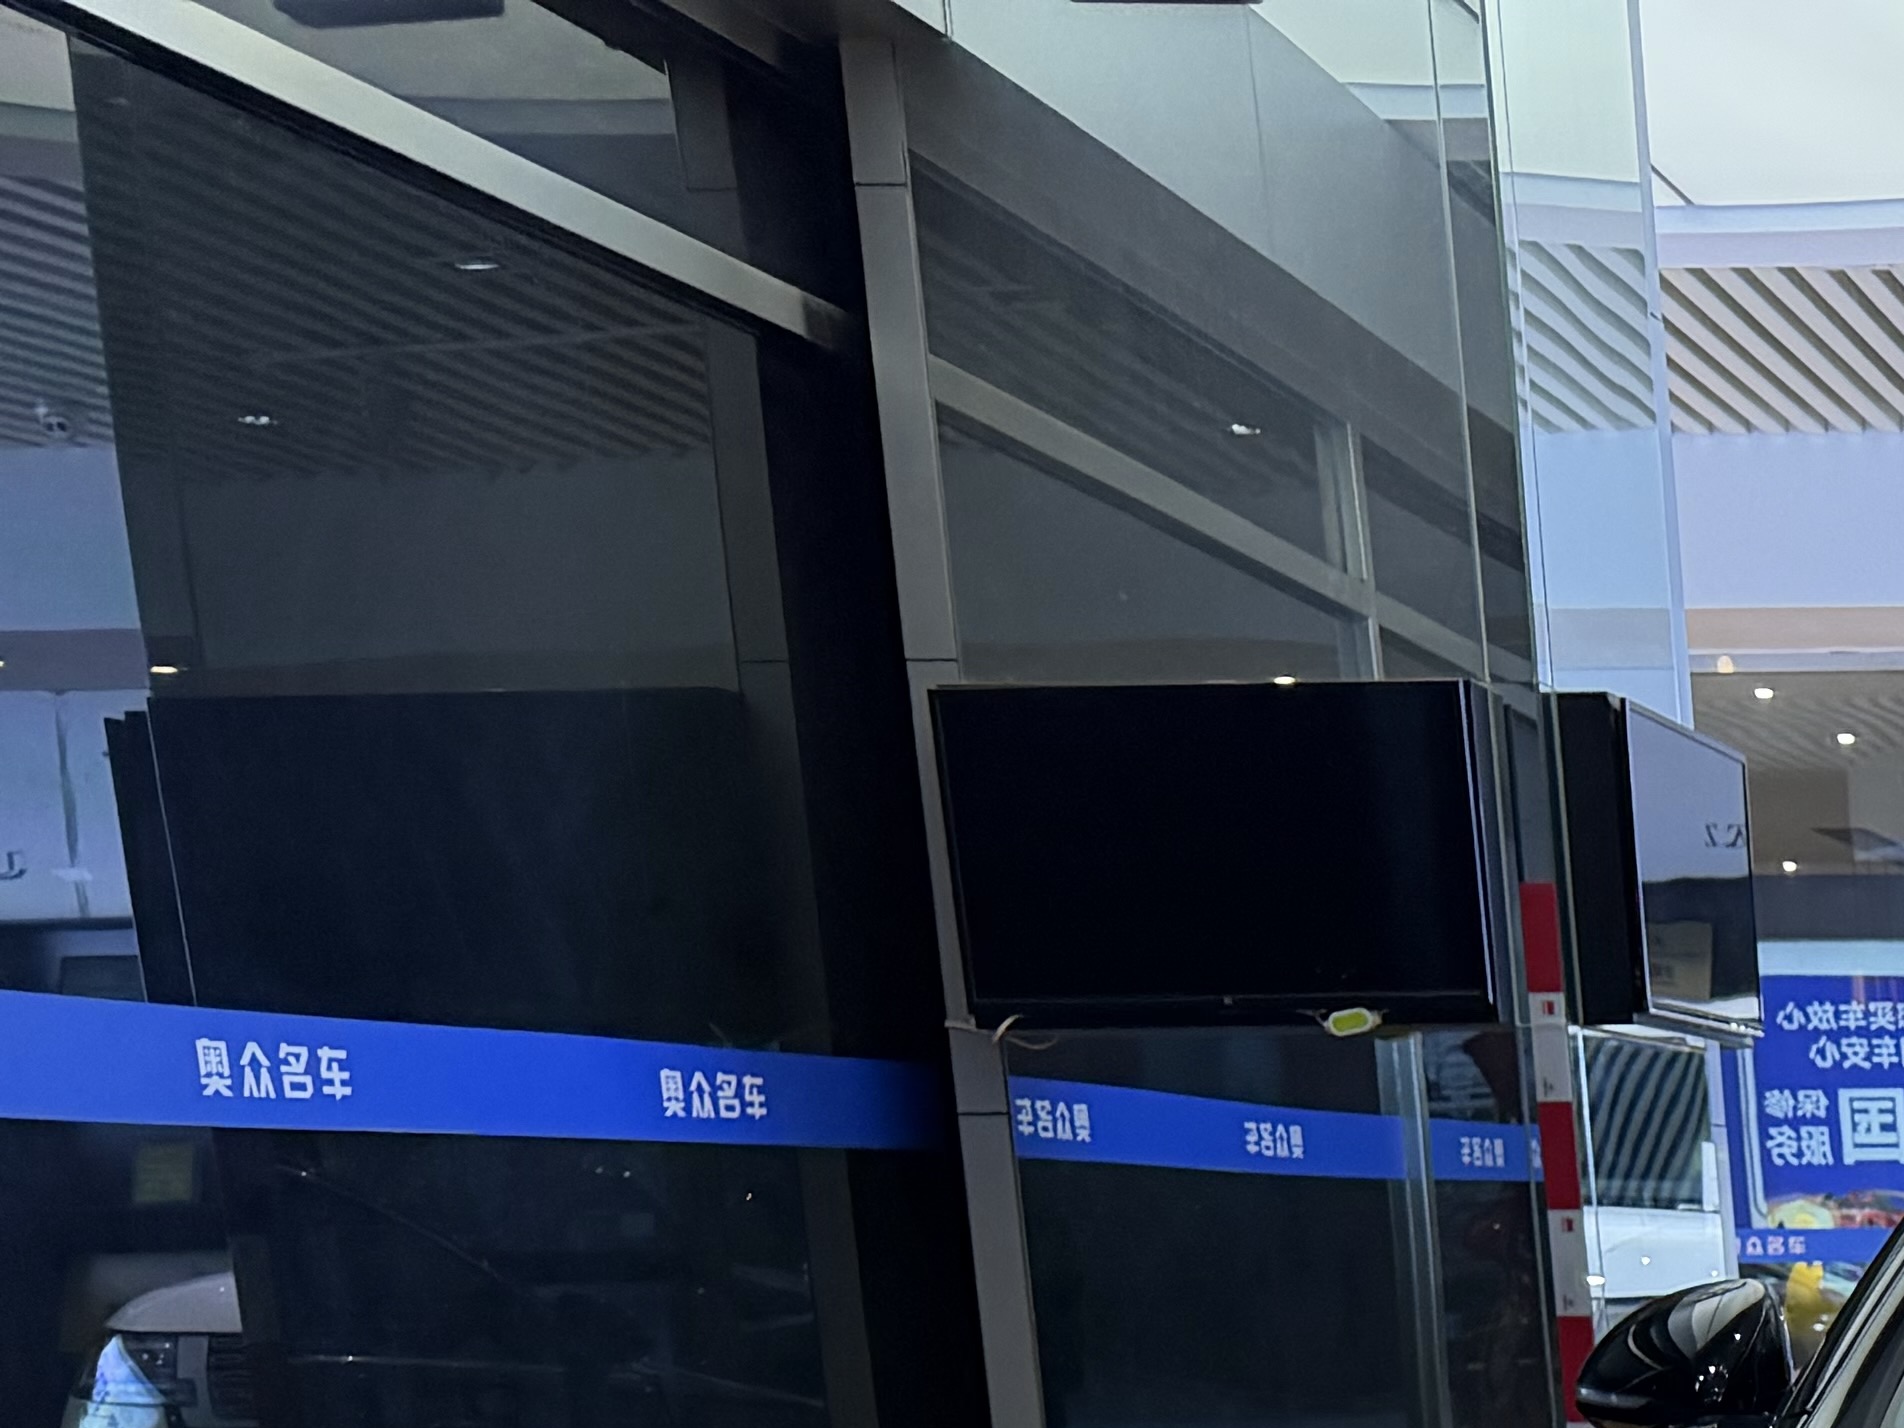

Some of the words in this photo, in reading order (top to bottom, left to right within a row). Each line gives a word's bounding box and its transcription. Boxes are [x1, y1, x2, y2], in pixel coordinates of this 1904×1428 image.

[195, 1037, 352, 1101] 奥众名车
[659, 1067, 768, 1120] 奥众名车
